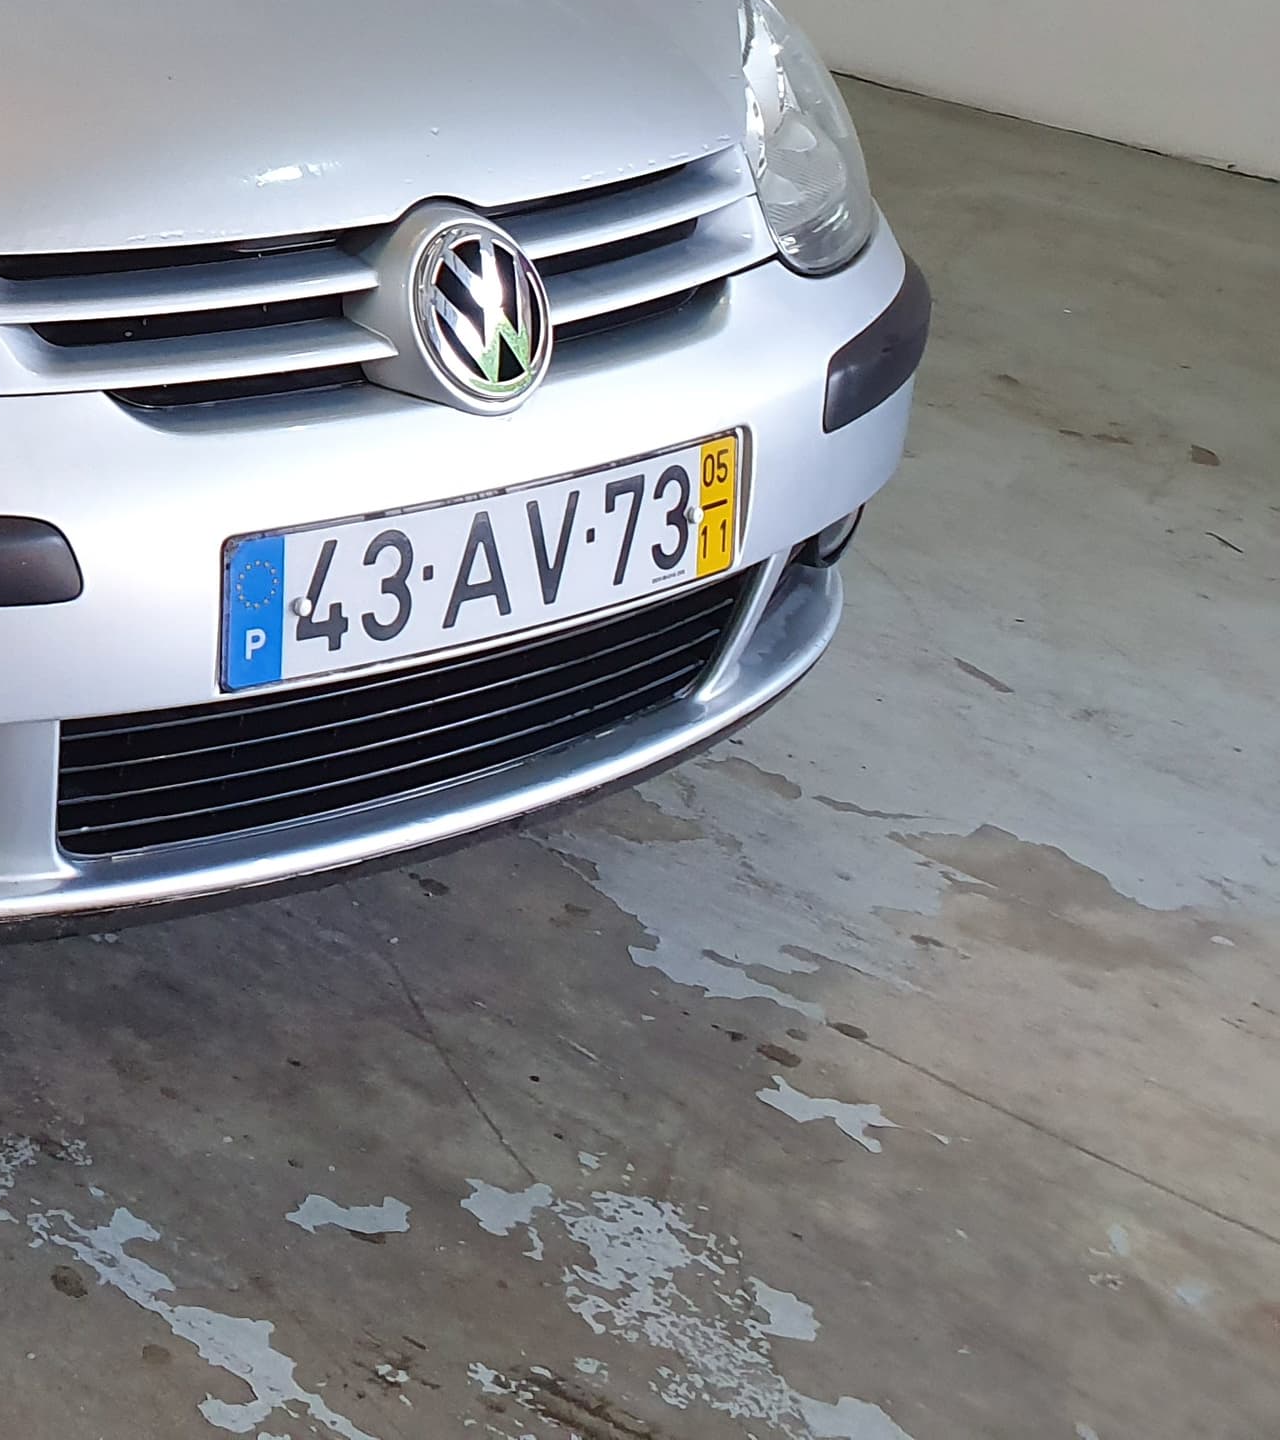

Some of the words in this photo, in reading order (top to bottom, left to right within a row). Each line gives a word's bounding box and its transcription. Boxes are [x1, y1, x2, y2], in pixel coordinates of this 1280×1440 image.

[420, 227, 544, 397] VW
[703, 449, 728, 487] 05
[701, 519, 726, 559] 11
[245, 628, 266, 660] P
